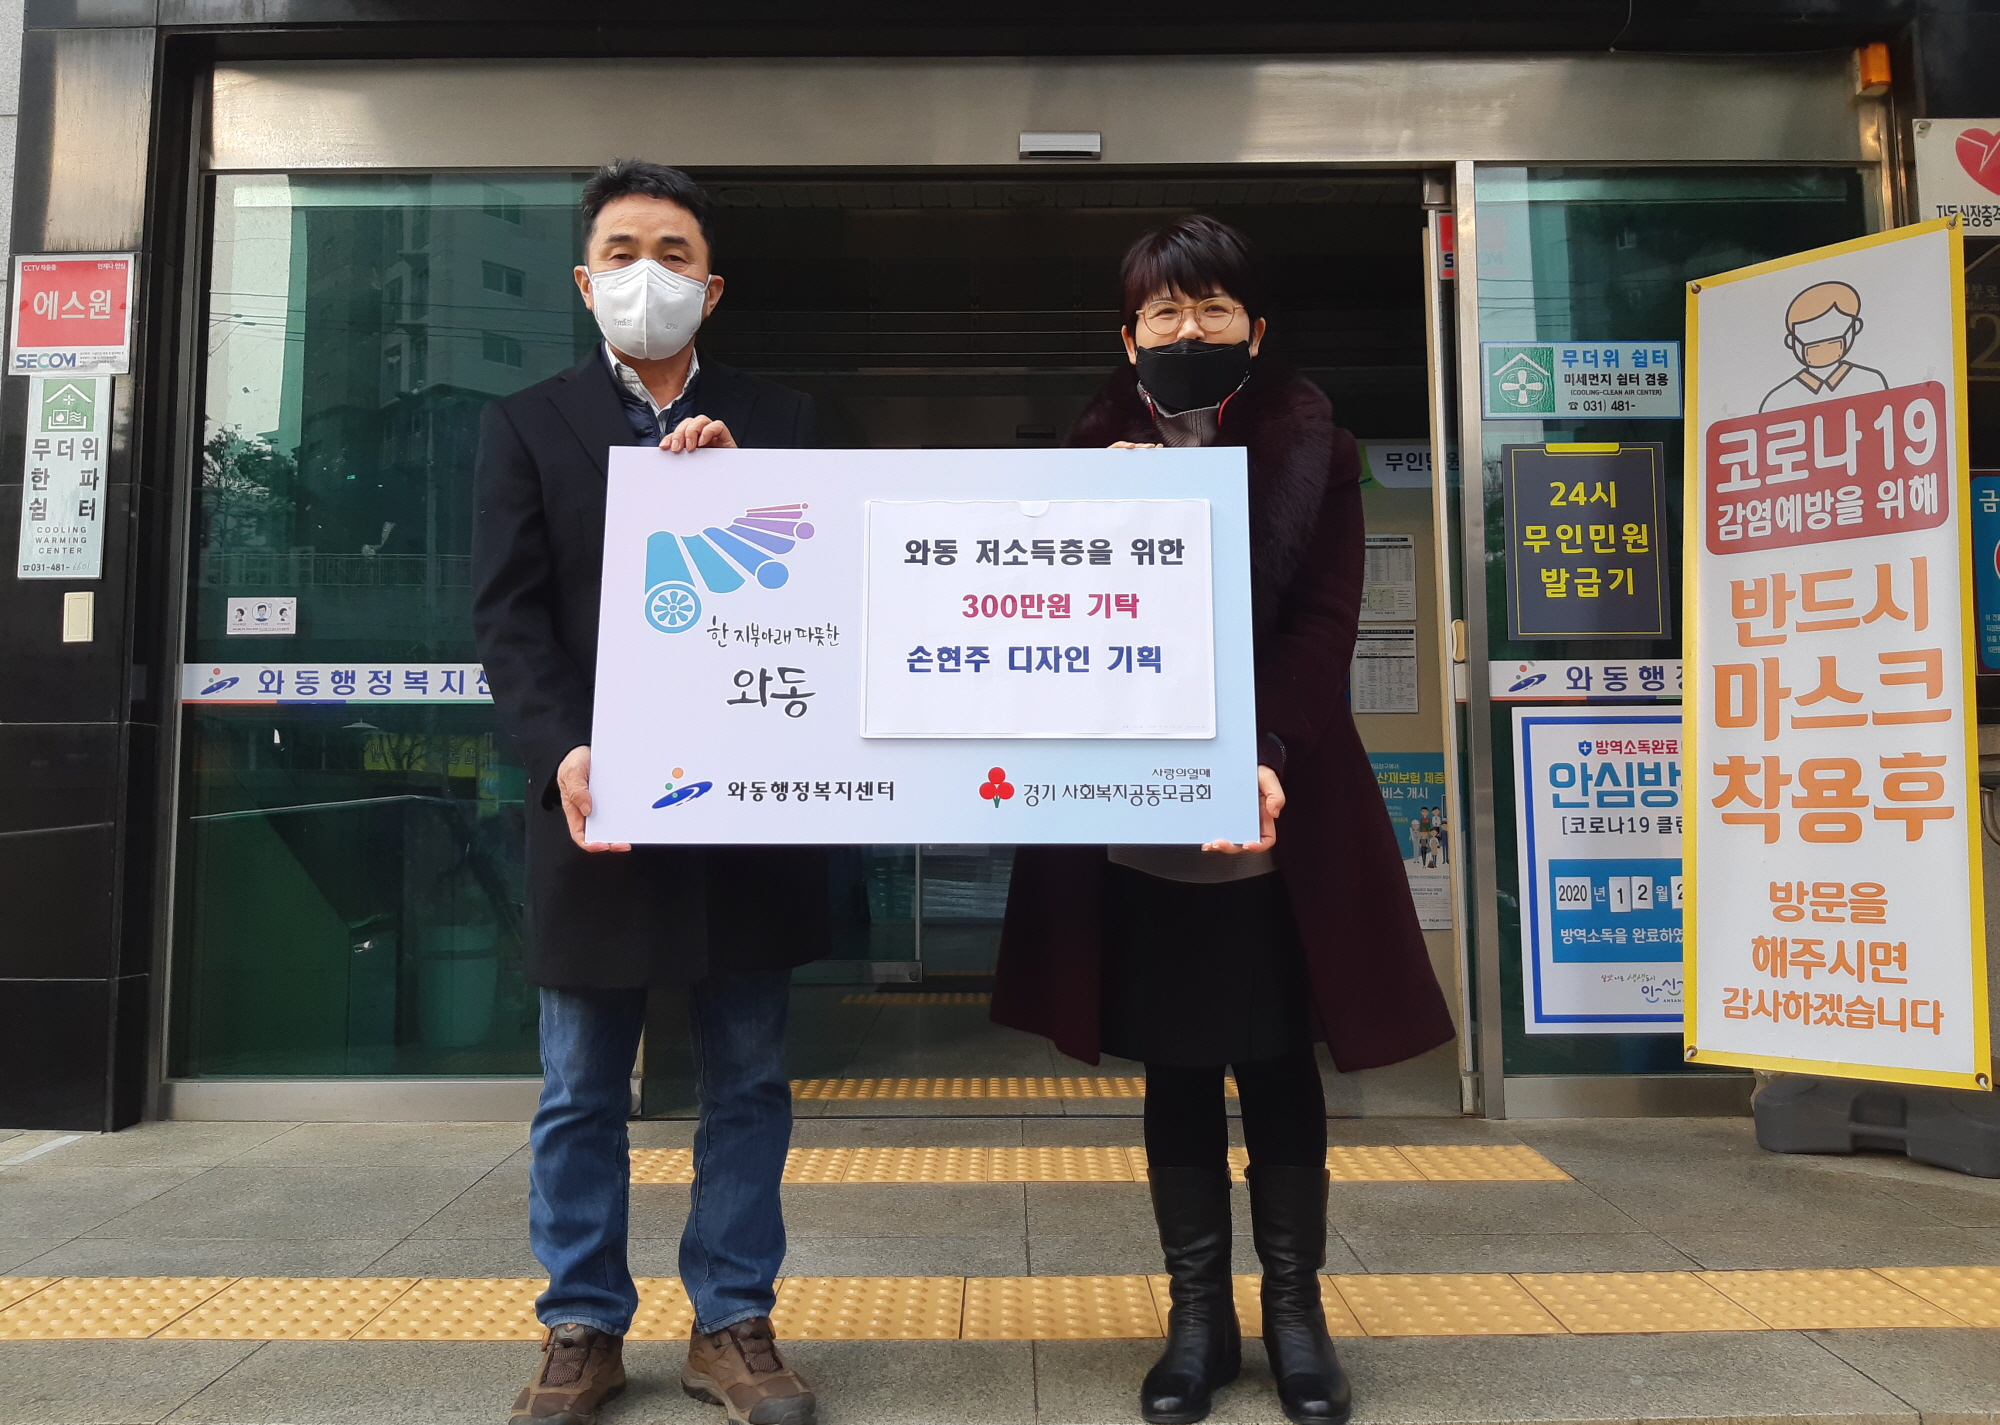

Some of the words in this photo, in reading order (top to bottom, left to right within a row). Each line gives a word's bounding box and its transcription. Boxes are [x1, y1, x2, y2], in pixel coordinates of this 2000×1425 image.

[33, 290, 111, 320] 에스원
[16, 353, 76, 368] SECOM
[1562, 349, 1619, 368] 무더위
[1631, 349, 1668, 368] 쉼터
[1564, 373, 1611, 386] 미세먼지
[1616, 373, 1640, 386] 쉼터
[1645, 373, 1668, 386] 겸용
[1583, 400, 1606, 412] 031)
[1611, 400, 1636, 411] 481-
[32, 438, 99, 461] 무더위
[1716, 397, 1937, 493] 코로나19
[1550, 481, 1616, 508] 24시
[1717, 485, 1864, 541] 감염예방을
[1876, 473, 1938, 519] 위해
[1523, 523, 1649, 554] 무인민원
[904, 539, 958, 566] 와동
[976, 539, 1113, 566] 저소득층을
[1130, 539, 1185, 566] 위한
[1541, 568, 1634, 598] 발급기
[962, 593, 1071, 619] 300만원
[1087, 593, 1139, 619] 기탁
[1730, 556, 1929, 647] 반드시
[707, 615, 729, 647] 한
[734, 622, 791, 648] 지붕아래
[795, 622, 841, 648] 따뜻한
[906, 645, 990, 673] 손현주
[1009, 645, 1090, 673] 디자인
[1107, 645, 1162, 673] 기획
[726, 666, 816, 718] 와동
[1566, 666, 1682, 691] 와동행
[1712, 648, 1952, 741] 마스크
[1595, 740, 1682, 755] 방역소독완료
[1152, 767, 1211, 780] 사랑의열매
[1377, 772, 1420, 784] 산재보험
[1549, 761, 1682, 808] 안심방
[727, 781, 894, 802] 와동행정복지센터
[1023, 783, 1056, 807] 경기
[1062, 783, 1212, 807] 사회복지공동모금회
[1381, 787, 1404, 799] 비스
[1407, 787, 1428, 799] 개시
[1711, 752, 1955, 844] 착용후
[1562, 816, 1650, 835] [코로나19
[1558, 885, 1588, 901] 2020
[1656, 885, 1669, 902] 월
[1769, 880, 1888, 925] 방문을
[1561, 928, 1628, 944] 방역소독을
[1751, 935, 1908, 985] 해주시면
[1722, 987, 1944, 1036] 감사하겠습니다
